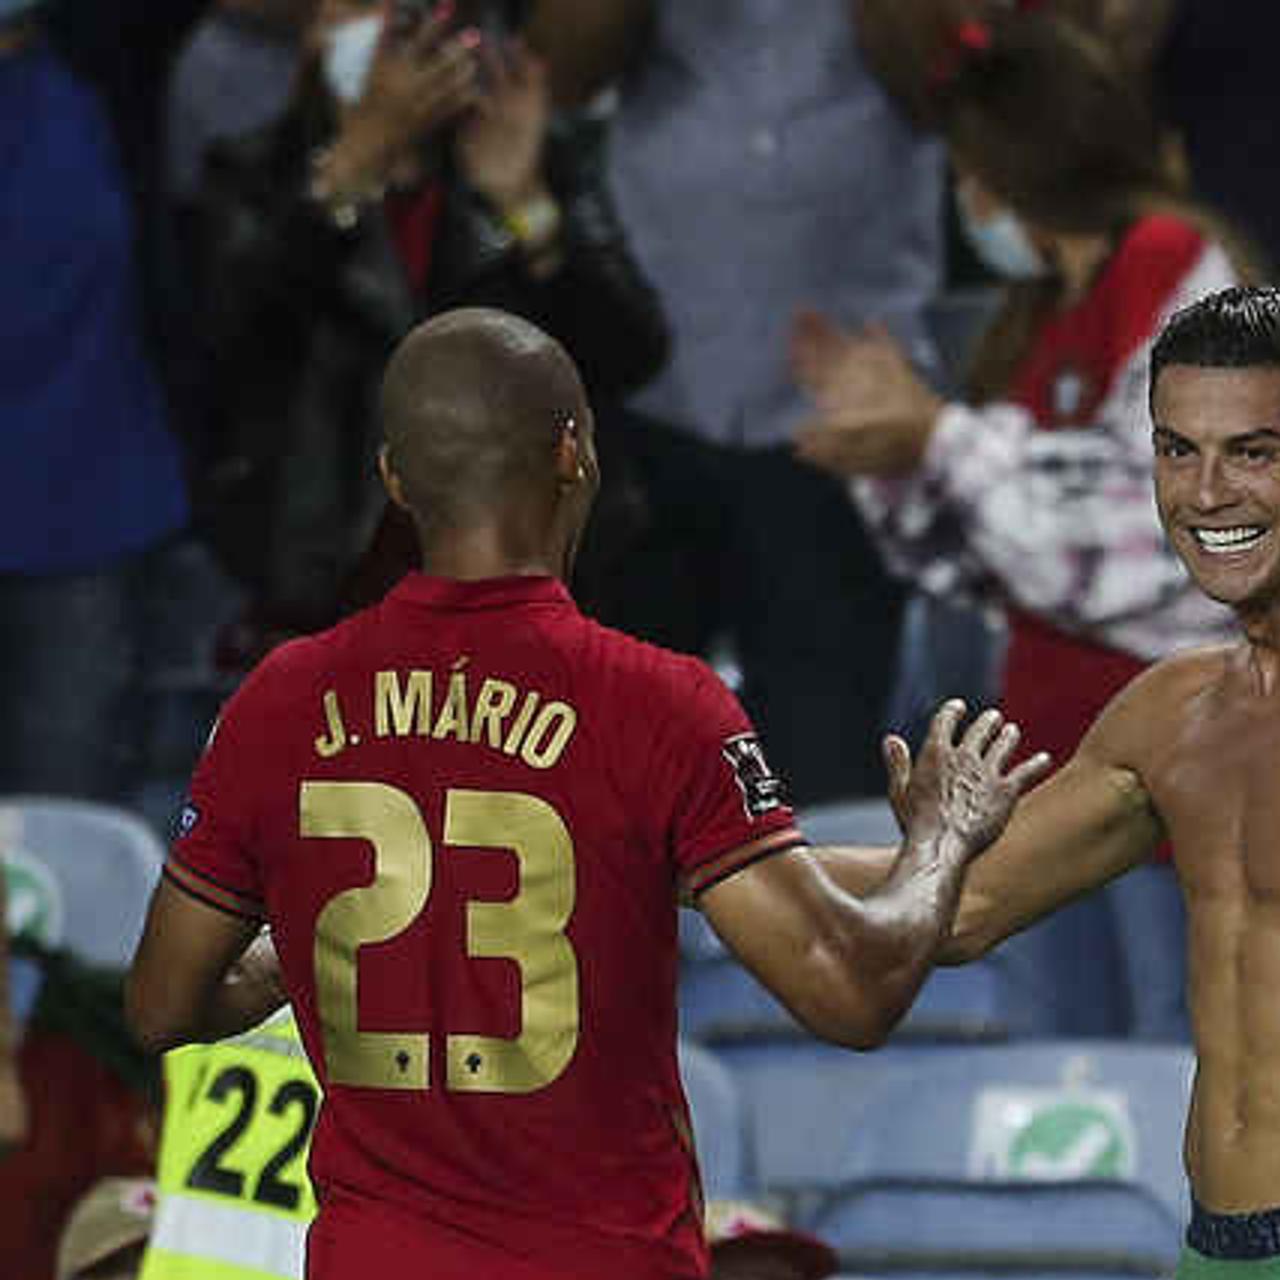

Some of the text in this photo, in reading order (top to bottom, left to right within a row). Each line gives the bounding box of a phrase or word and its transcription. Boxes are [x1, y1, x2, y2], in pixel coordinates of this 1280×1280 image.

[315, 656, 577, 769] J. MÁRIO
[300, 780, 580, 1095] 23
[186, 1064, 318, 1211] 22
